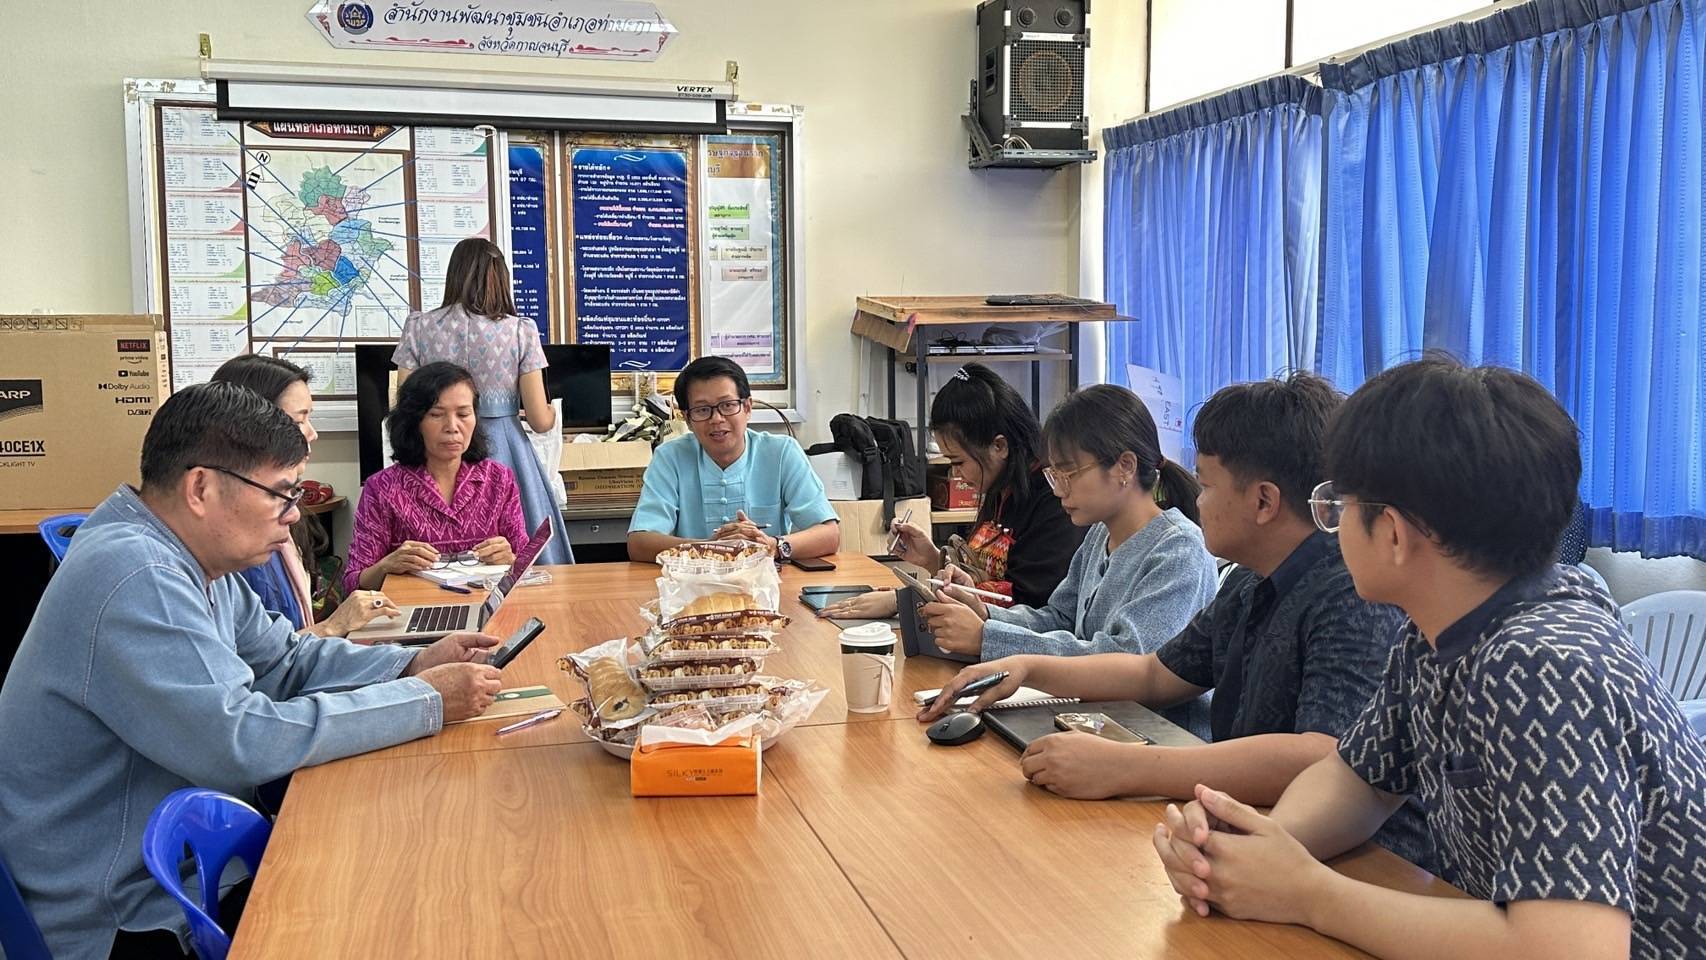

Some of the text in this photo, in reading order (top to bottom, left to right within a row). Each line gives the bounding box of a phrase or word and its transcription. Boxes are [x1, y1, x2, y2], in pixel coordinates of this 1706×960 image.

[478, 36, 570, 57] จังหวัดกาญจนบุรี
[273, 121, 370, 135] แผนทอำเภอทามะกา
[120, 342, 148, 350] NETFLIX
[108, 383, 129, 391] Dolby
[115, 396, 151, 404] HDMI
[664, 768, 695, 778] SILKY
